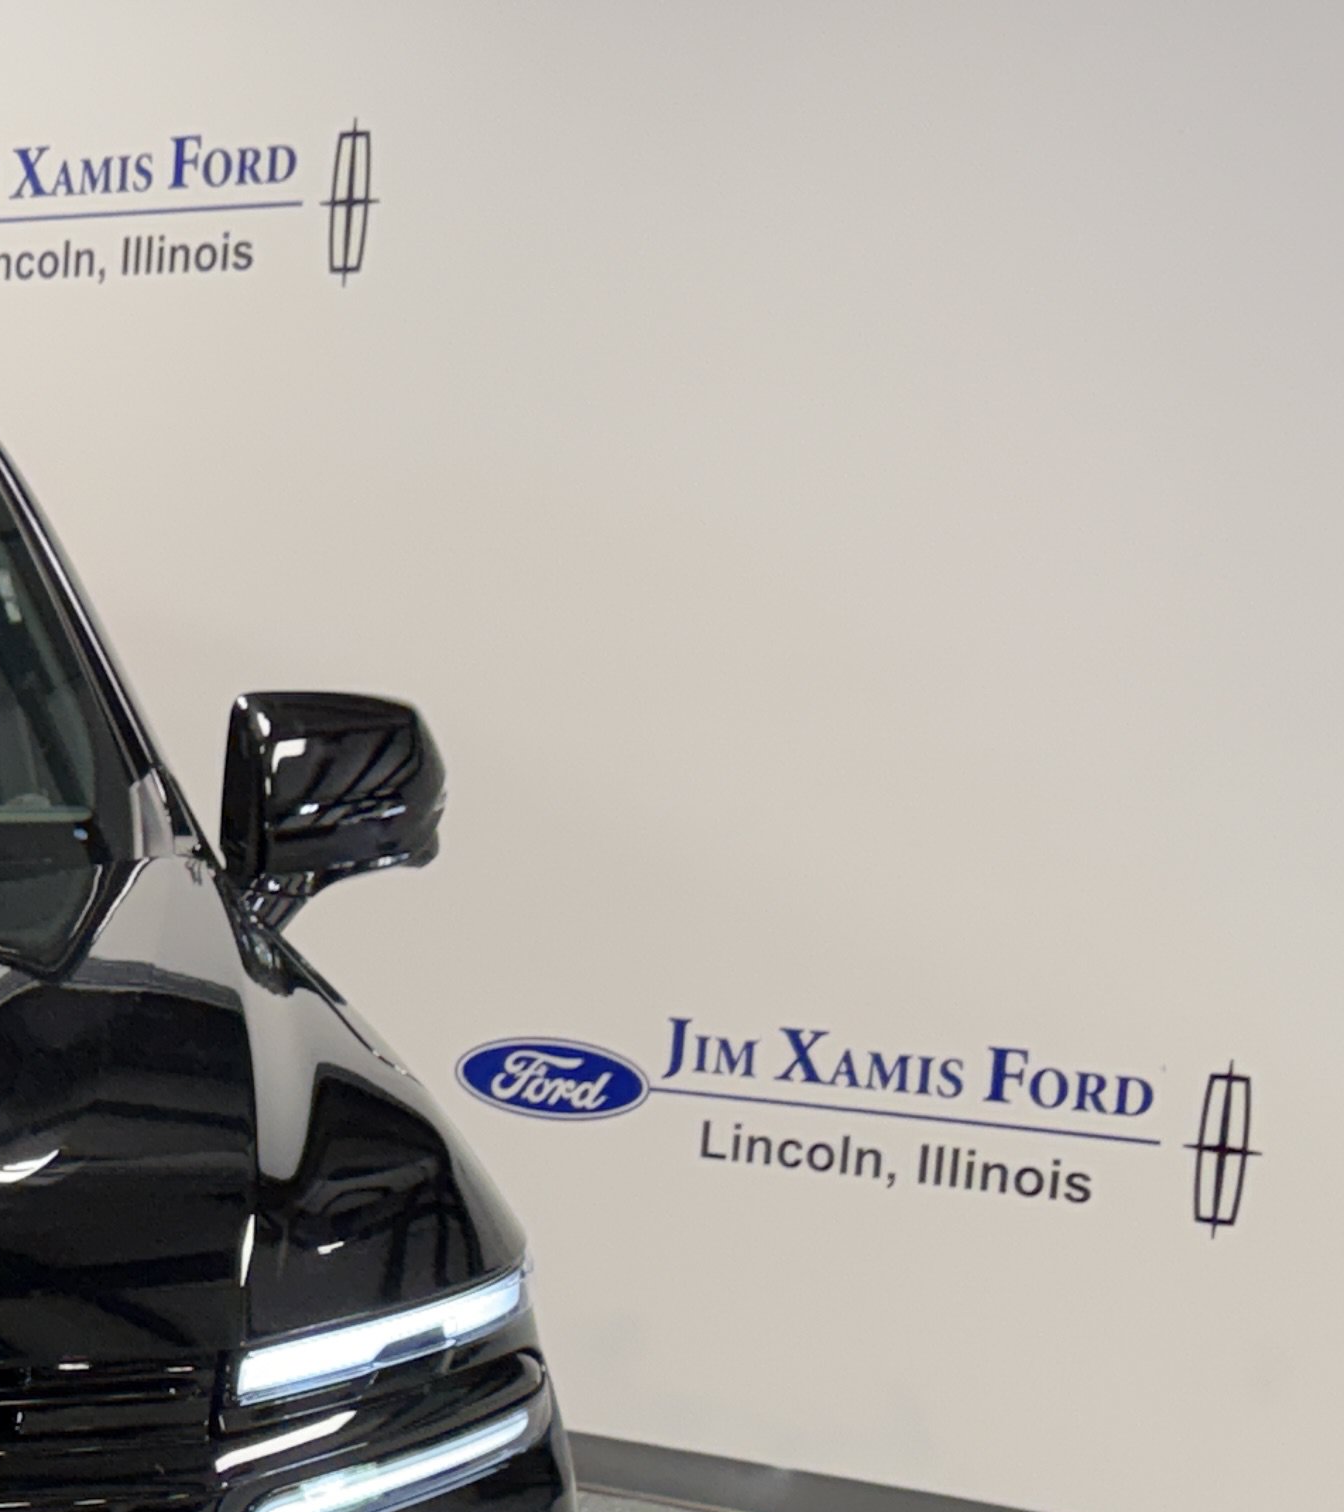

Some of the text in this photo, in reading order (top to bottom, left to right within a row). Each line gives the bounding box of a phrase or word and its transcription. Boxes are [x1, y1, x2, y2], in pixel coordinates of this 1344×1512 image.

[9, 145, 154, 200] XAMIS
[168, 134, 297, 189] FORD
[121, 232, 253, 277] Illinois
[491, 1051, 607, 1112] Ford
[662, 1017, 1154, 1119] JIM XAMIS FORD
[700, 1120, 1093, 1205] Lincoln, Illinois
